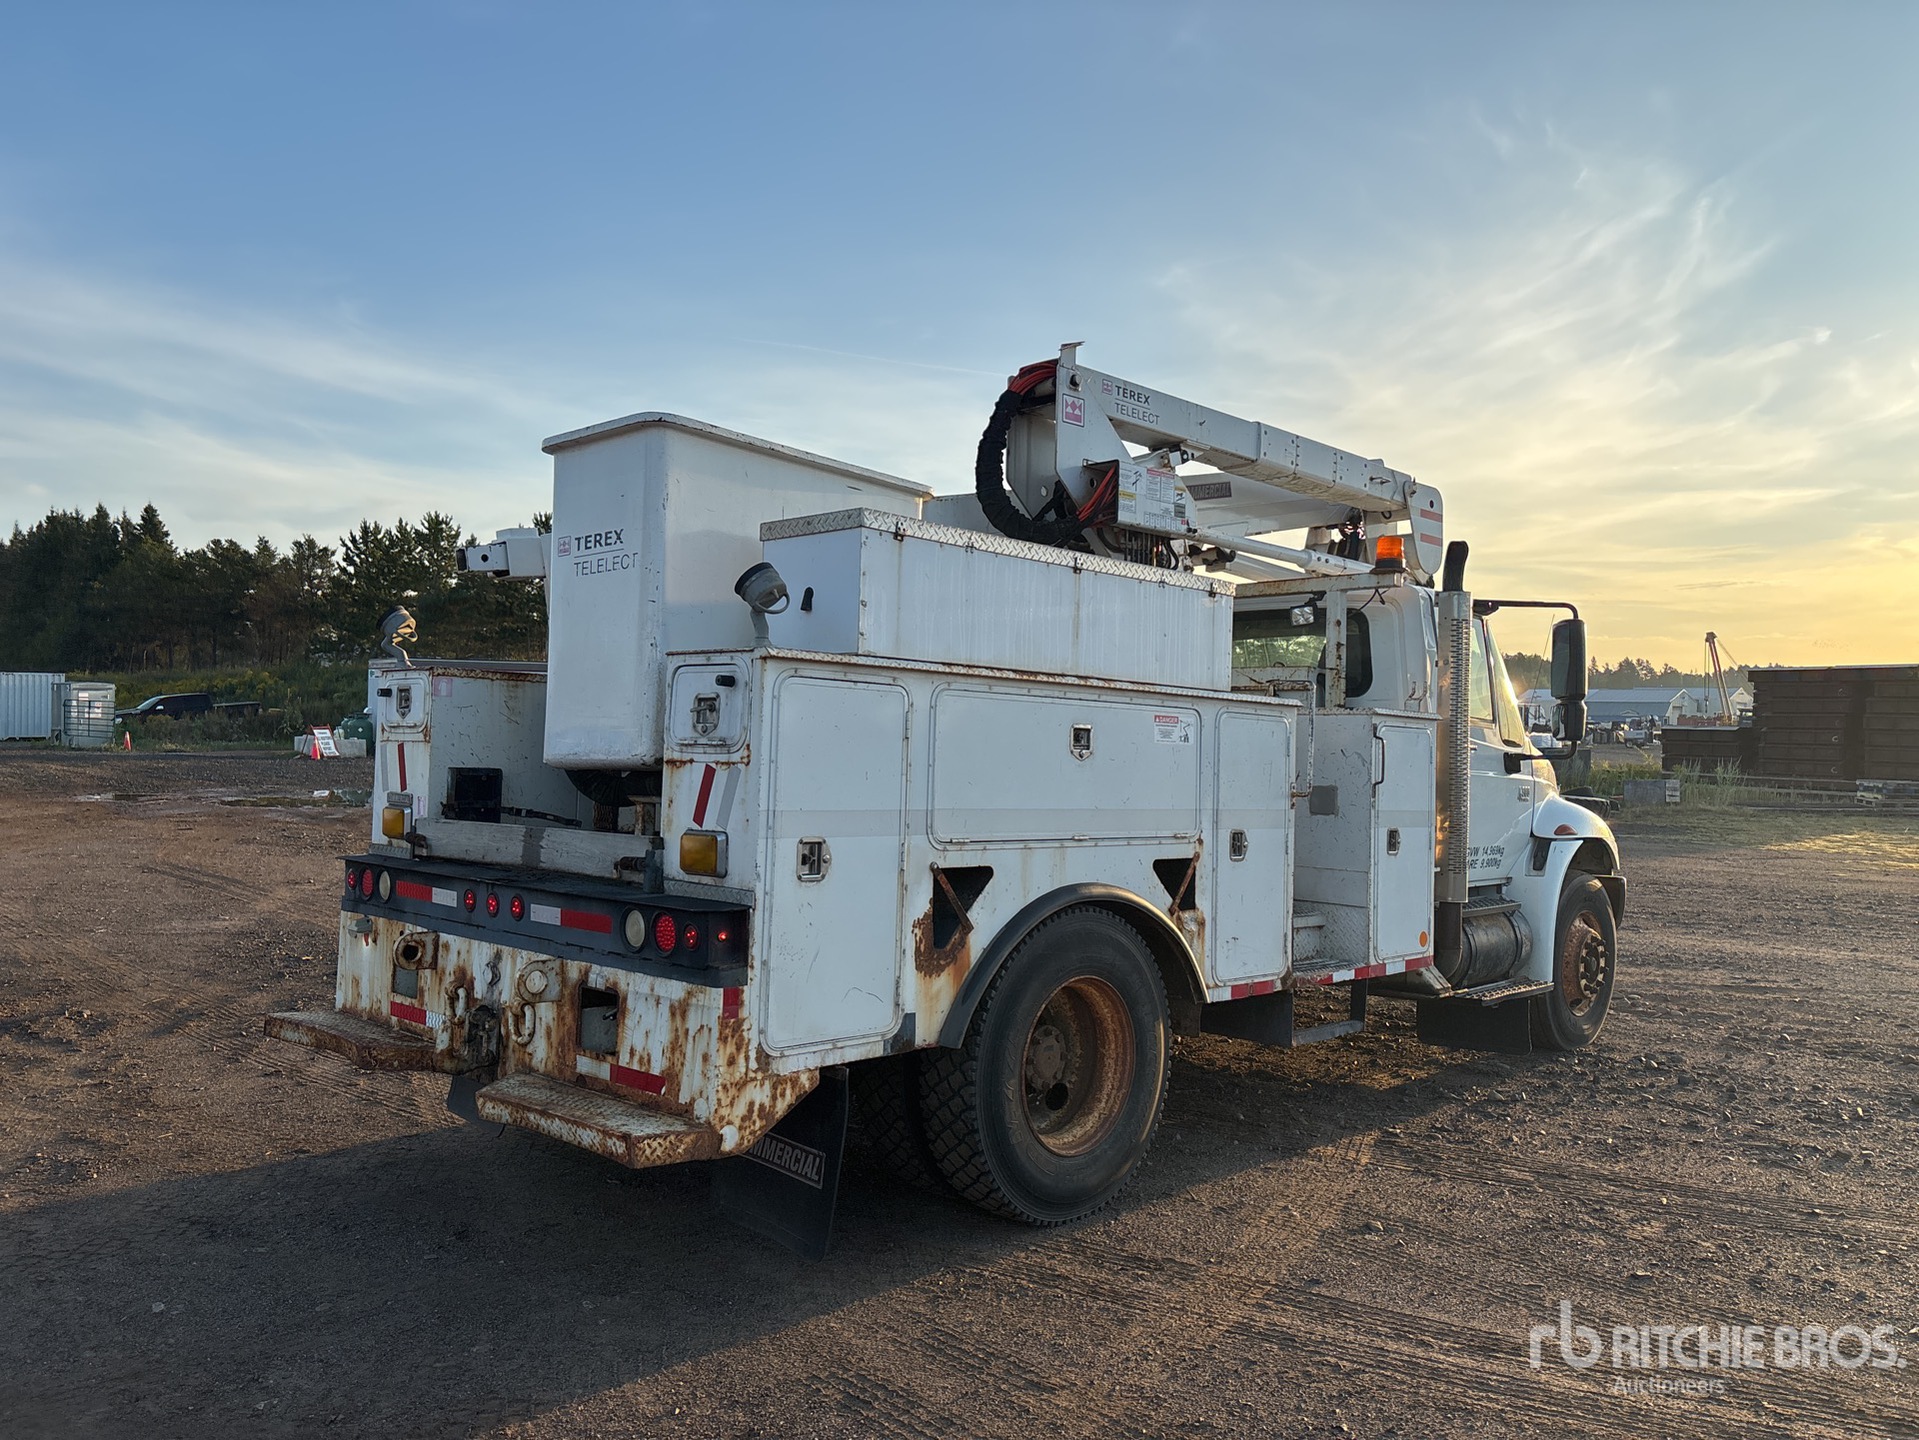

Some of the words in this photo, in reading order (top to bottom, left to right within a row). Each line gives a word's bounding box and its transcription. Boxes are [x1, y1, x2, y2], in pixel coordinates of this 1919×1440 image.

[1115, 385, 1151, 405] TEREX
[1115, 403, 1160, 425] TELELECT
[1187, 483, 1231, 499] MMERCIAL
[575, 529, 624, 551] TEREX
[574, 553, 638, 577] TELELECT
[1467, 859, 1479, 869] ARE
[749, 1137, 820, 1180] MMERCIAL
